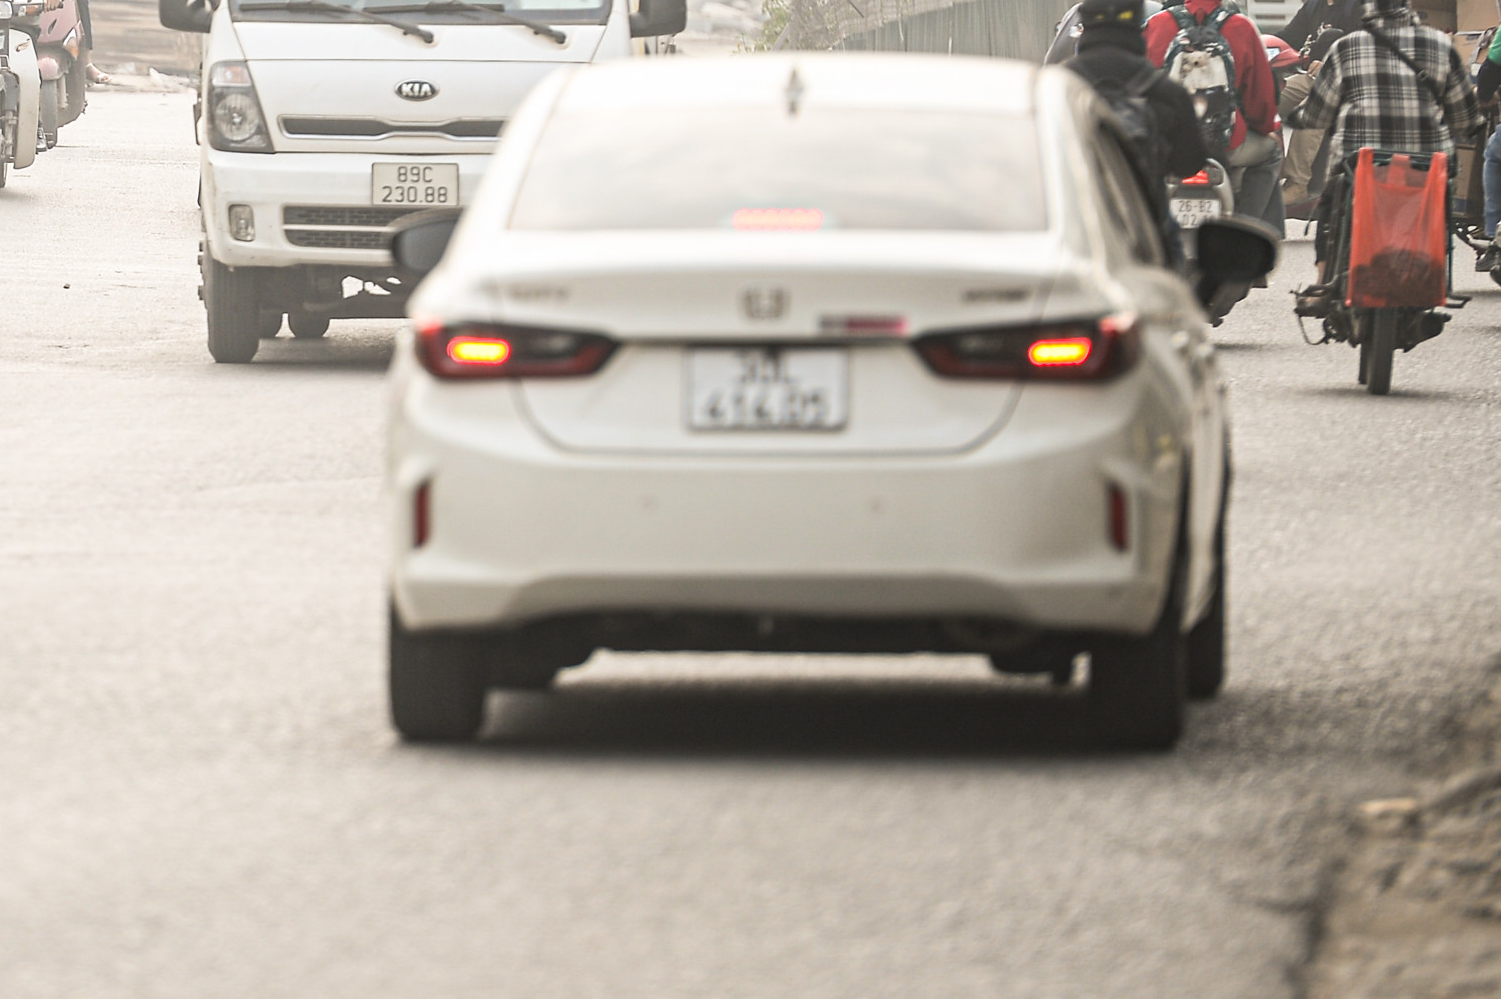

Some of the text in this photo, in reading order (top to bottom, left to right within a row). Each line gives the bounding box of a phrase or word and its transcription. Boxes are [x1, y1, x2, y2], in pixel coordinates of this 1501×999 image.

[401, 83, 432, 97] KIA
[397, 166, 433, 183] 89C
[382, 186, 448, 203] 230.88
[1179, 200, 1213, 213] 26-B2
